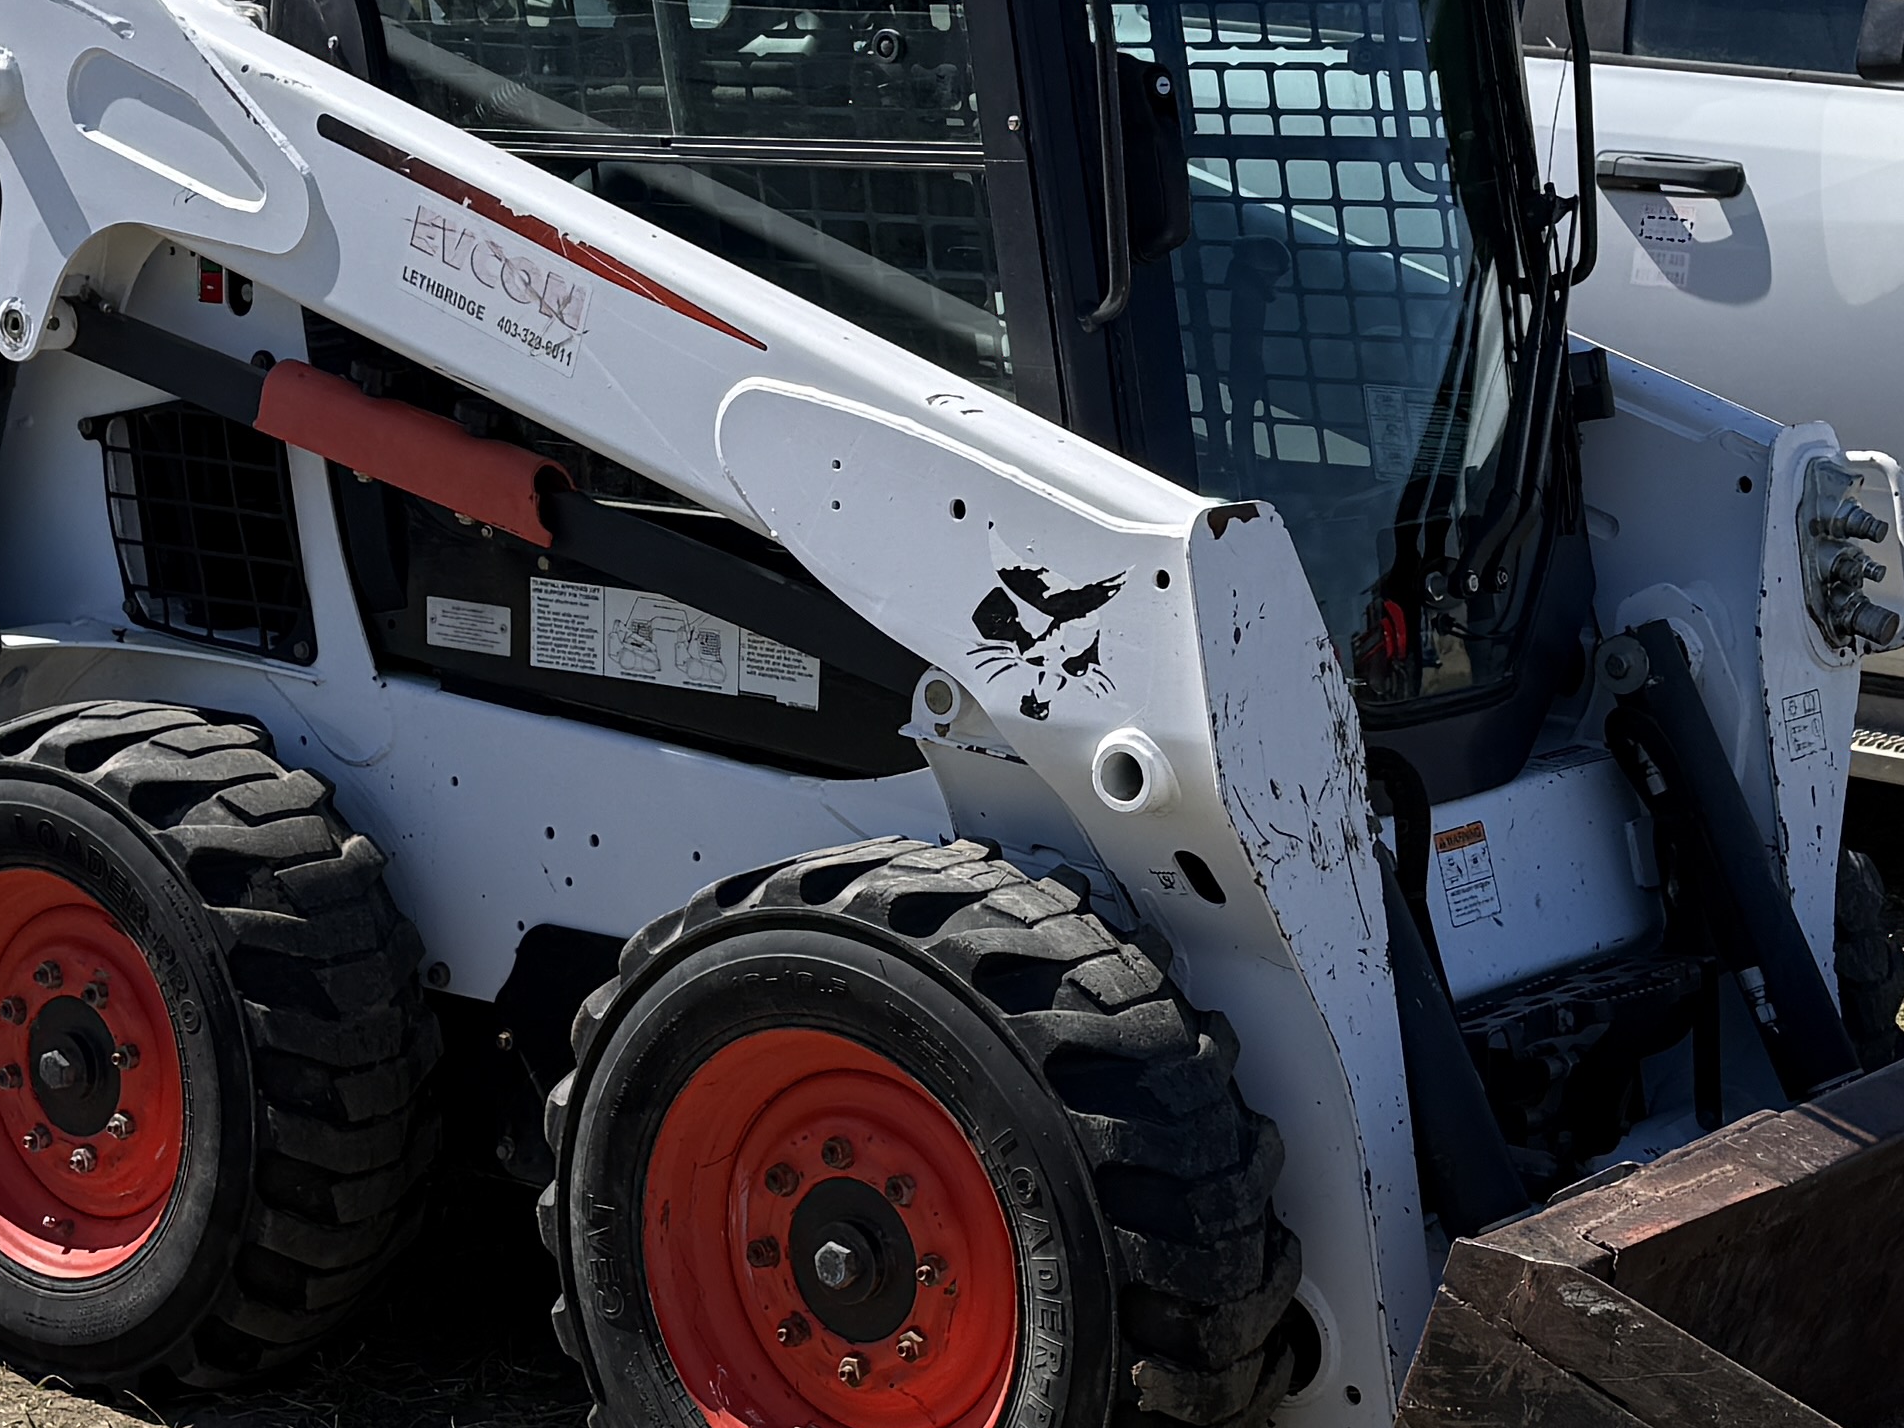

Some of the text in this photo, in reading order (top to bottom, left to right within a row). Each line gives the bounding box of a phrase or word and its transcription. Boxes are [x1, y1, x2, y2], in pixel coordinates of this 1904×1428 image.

[402, 265, 486, 322] LETHBRIDGE
[11, 811, 203, 1035] LOADER-PRO
[584, 1192, 625, 1320] CEAT
